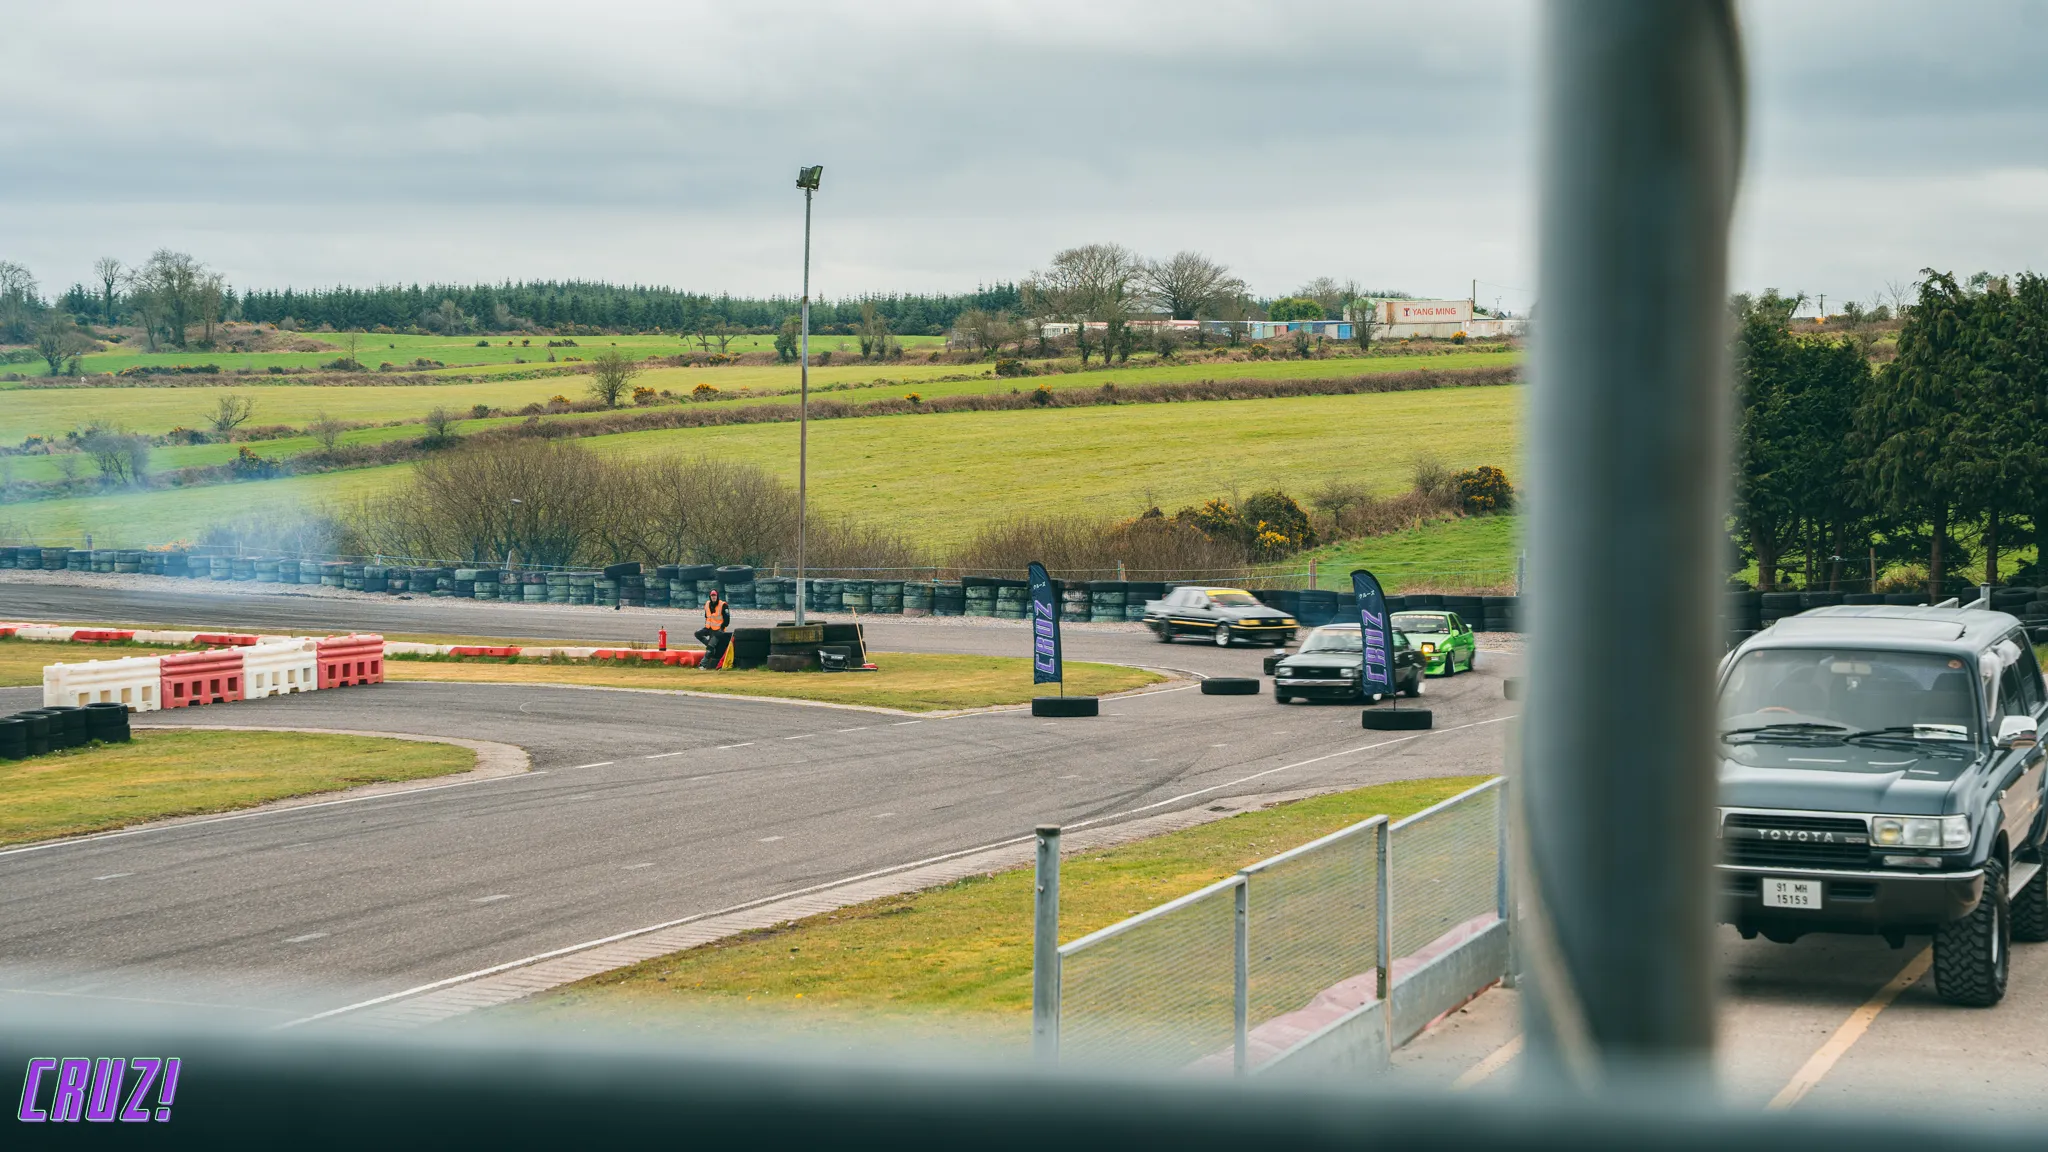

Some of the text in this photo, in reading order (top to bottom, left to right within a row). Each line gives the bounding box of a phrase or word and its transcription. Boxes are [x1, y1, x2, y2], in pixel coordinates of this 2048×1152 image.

[1412, 307, 1457, 316] YANG MING
[1034, 600, 1055, 675] CRUZ
[1361, 609, 1388, 686] CRUZ
[1757, 829, 1834, 843] TOYOTA
[1776, 882, 1808, 893] 91 MH
[1776, 894, 1808, 905] 15159
